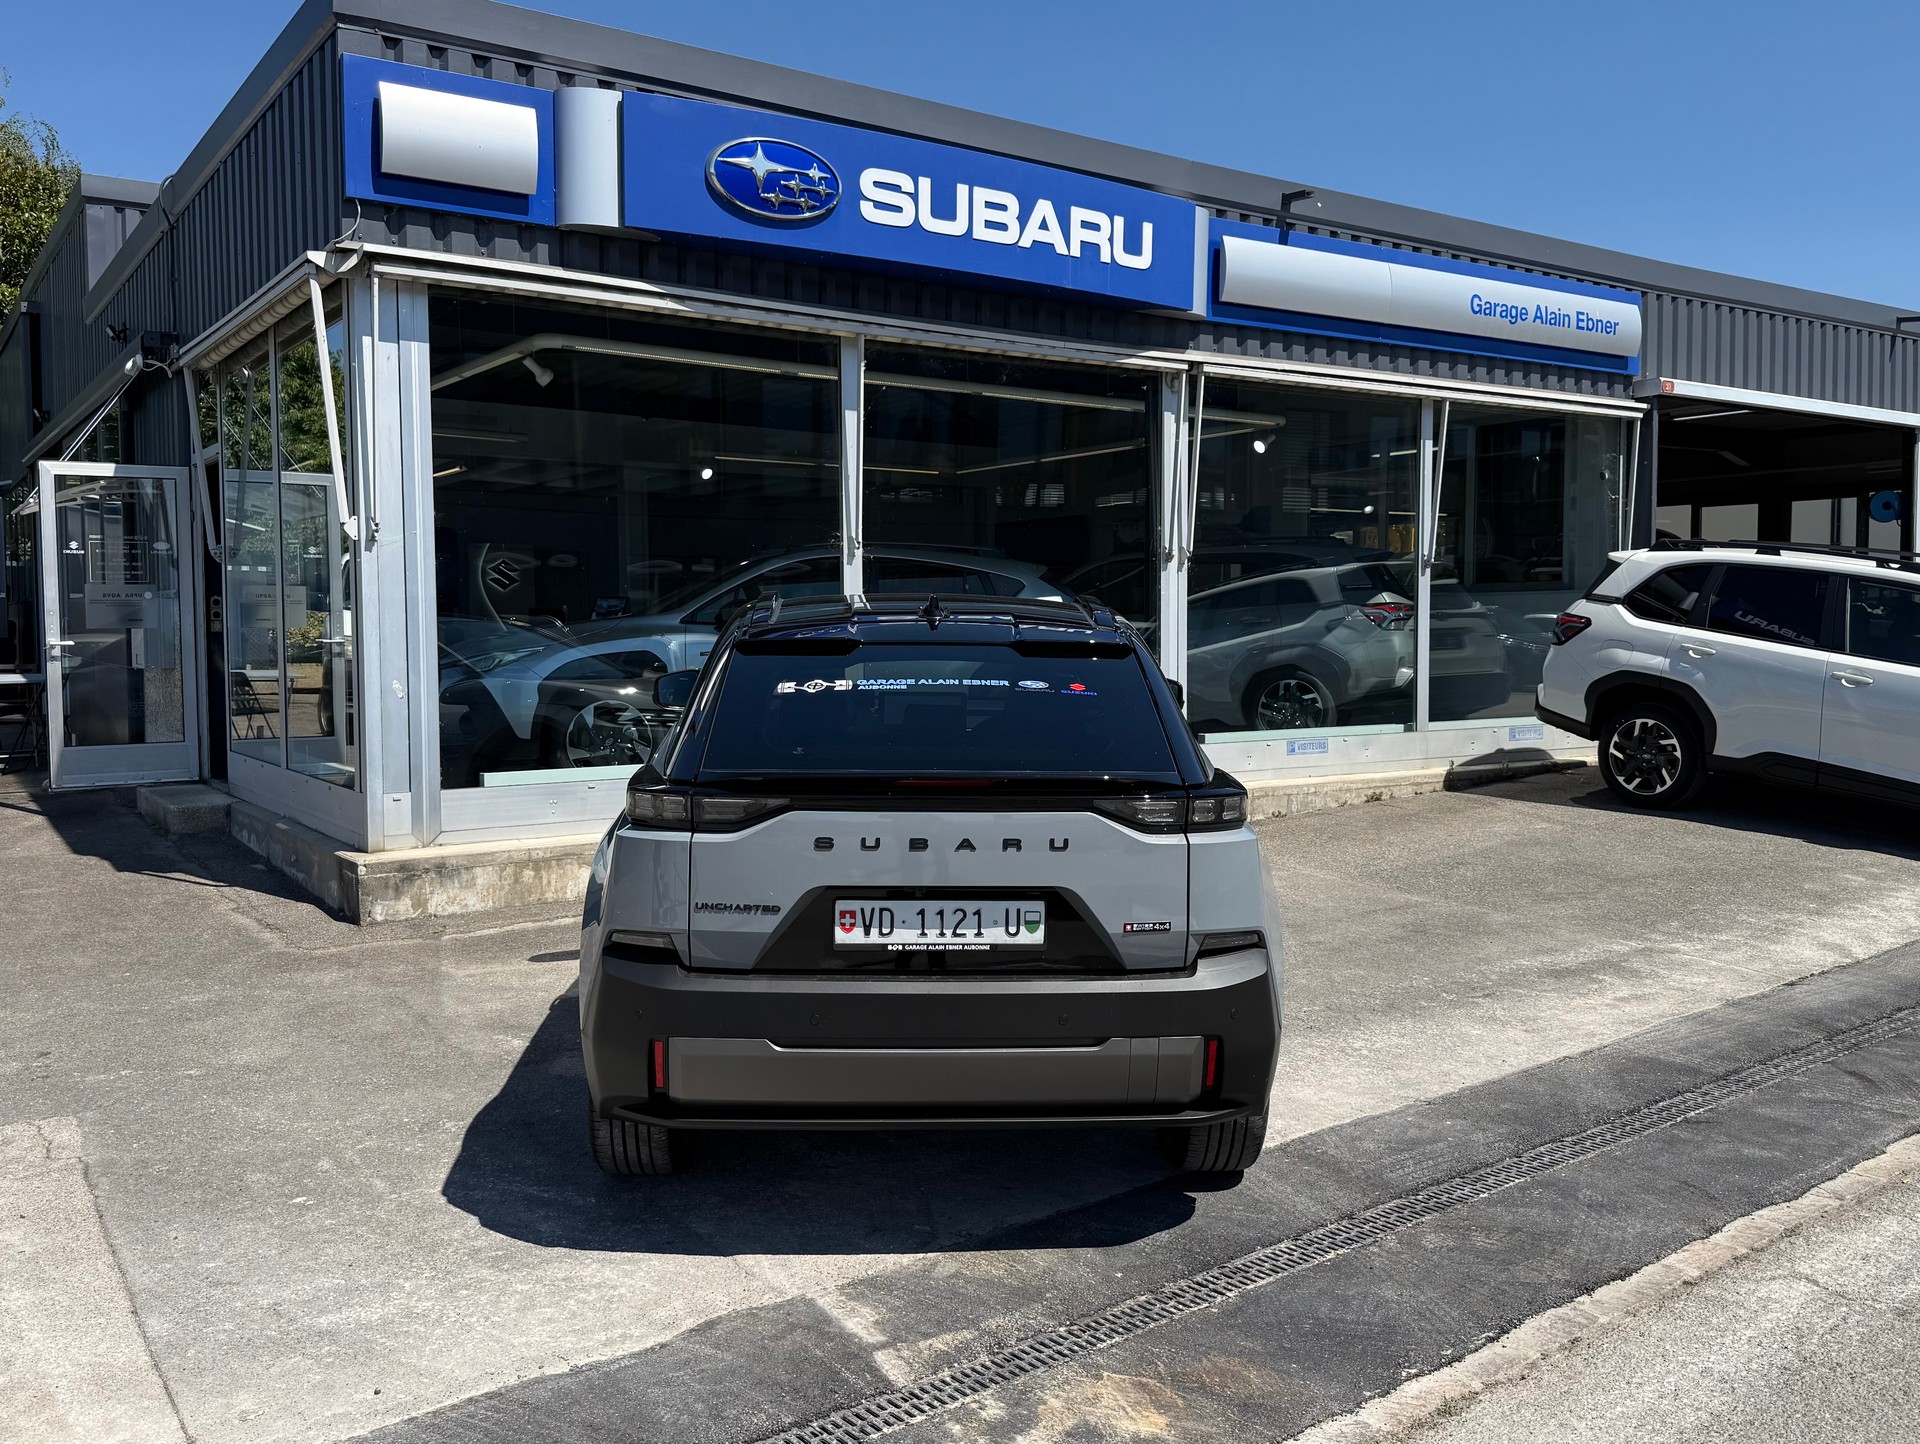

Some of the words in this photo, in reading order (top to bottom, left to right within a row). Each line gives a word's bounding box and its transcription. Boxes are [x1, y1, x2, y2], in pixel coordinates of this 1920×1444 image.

[859, 167, 1153, 270] SUBARU
[1470, 293, 1529, 325] Garage
[1532, 304, 1571, 329] Alain
[1575, 311, 1620, 336] Ebner
[962, 679, 1010, 687] EBNER
[1297, 741, 1327, 751] VISITEURS
[813, 836, 1070, 852] SUBARU
[694, 902, 782, 914] UNCHARTED
[859, 907, 895, 938] VD
[916, 907, 985, 938] 1121
[1004, 907, 1021, 938] U
[1153, 922, 1170, 930] 4x4
